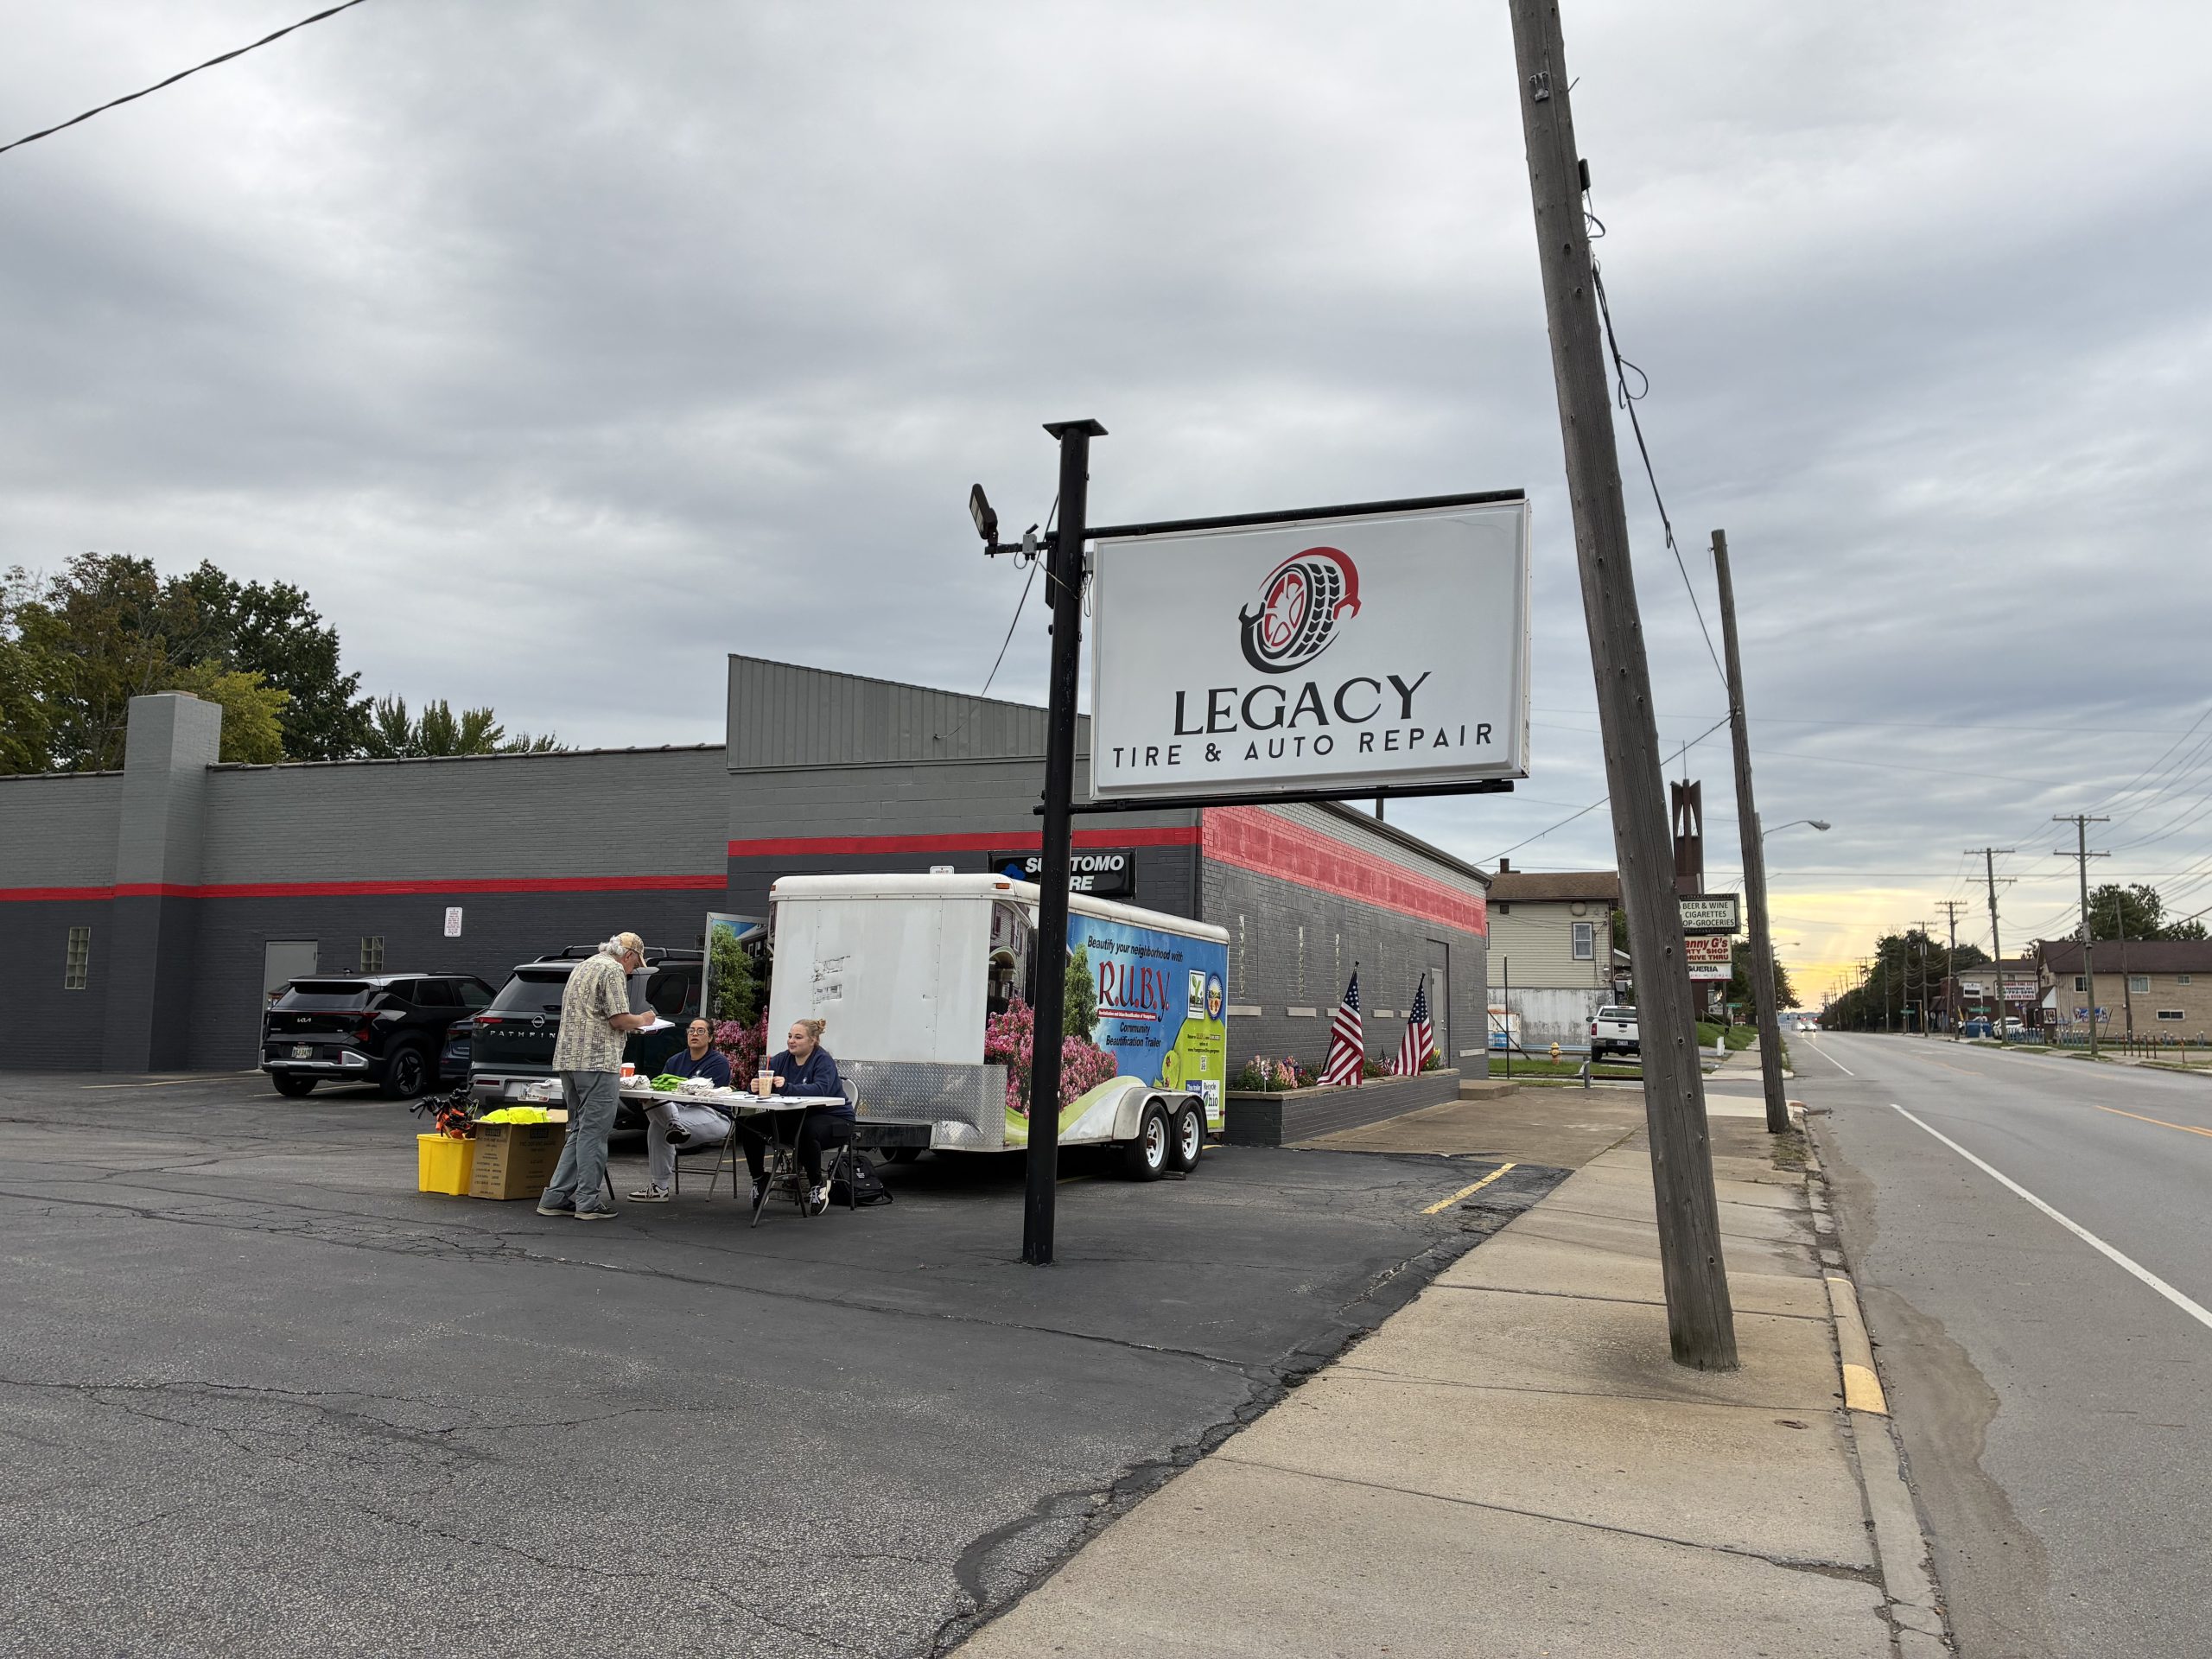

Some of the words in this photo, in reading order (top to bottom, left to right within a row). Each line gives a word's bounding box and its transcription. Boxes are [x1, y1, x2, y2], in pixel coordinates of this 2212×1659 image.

[1174, 671, 1433, 735] LEGACY
[1113, 744, 1182, 768] TIRE
[1205, 742, 1222, 762] &
[1244, 734, 1334, 761] AUTO
[1359, 722, 1493, 754] REPAIR
[1025, 855, 1125, 873] STOMO
[1071, 875, 1095, 891] RE
[1685, 910, 1727, 918] CIGARETTES
[1682, 918, 1735, 927] OP-GROCERIES
[1088, 935, 1116, 955] Beautify
[1116, 943, 1130, 955] your
[1130, 944, 1171, 960] neighborhood
[1171, 950, 1184, 963] with
[1685, 939, 1710, 950] anny
[1711, 938, 1728, 949] G's
[1120, 1021, 1150, 1034] Community
[490, 1030, 556, 1039] PATHFIN
[1106, 1034, 1144, 1046] Beautification
[1145, 1036, 1161, 1047] Trailer
